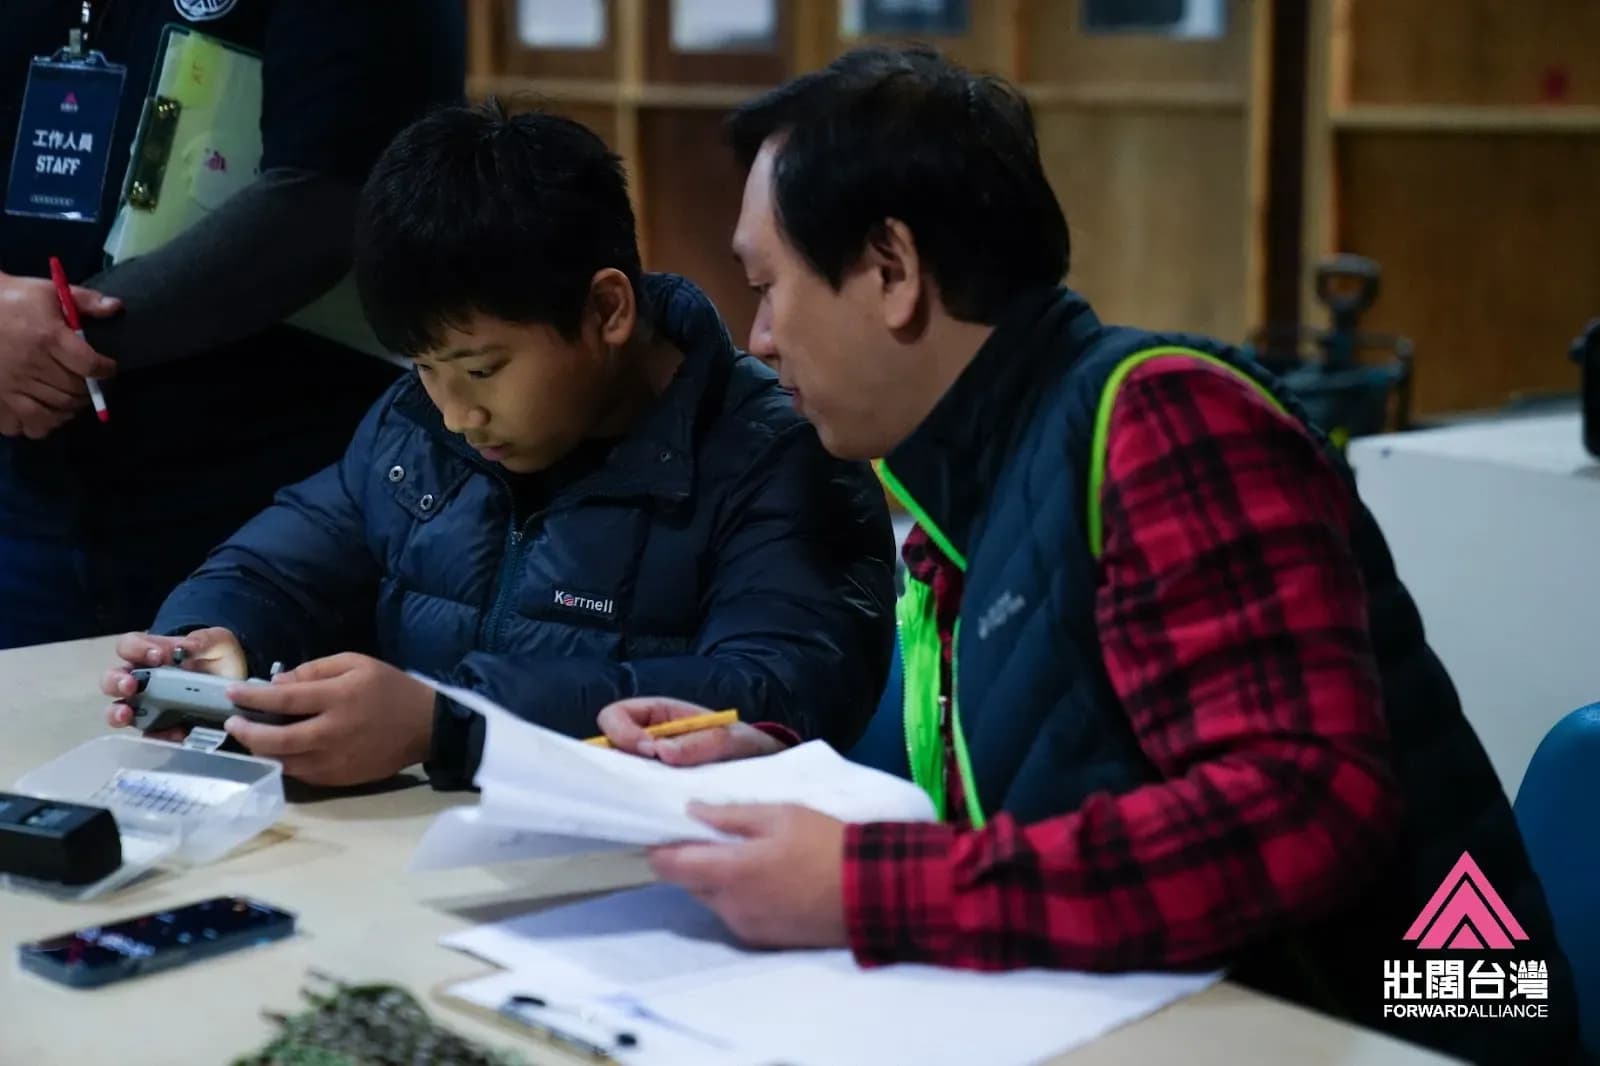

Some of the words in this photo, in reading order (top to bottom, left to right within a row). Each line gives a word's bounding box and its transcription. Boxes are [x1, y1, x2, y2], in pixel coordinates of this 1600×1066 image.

[32, 129, 94, 152] 工作人員
[35, 155, 81, 176] STAFF
